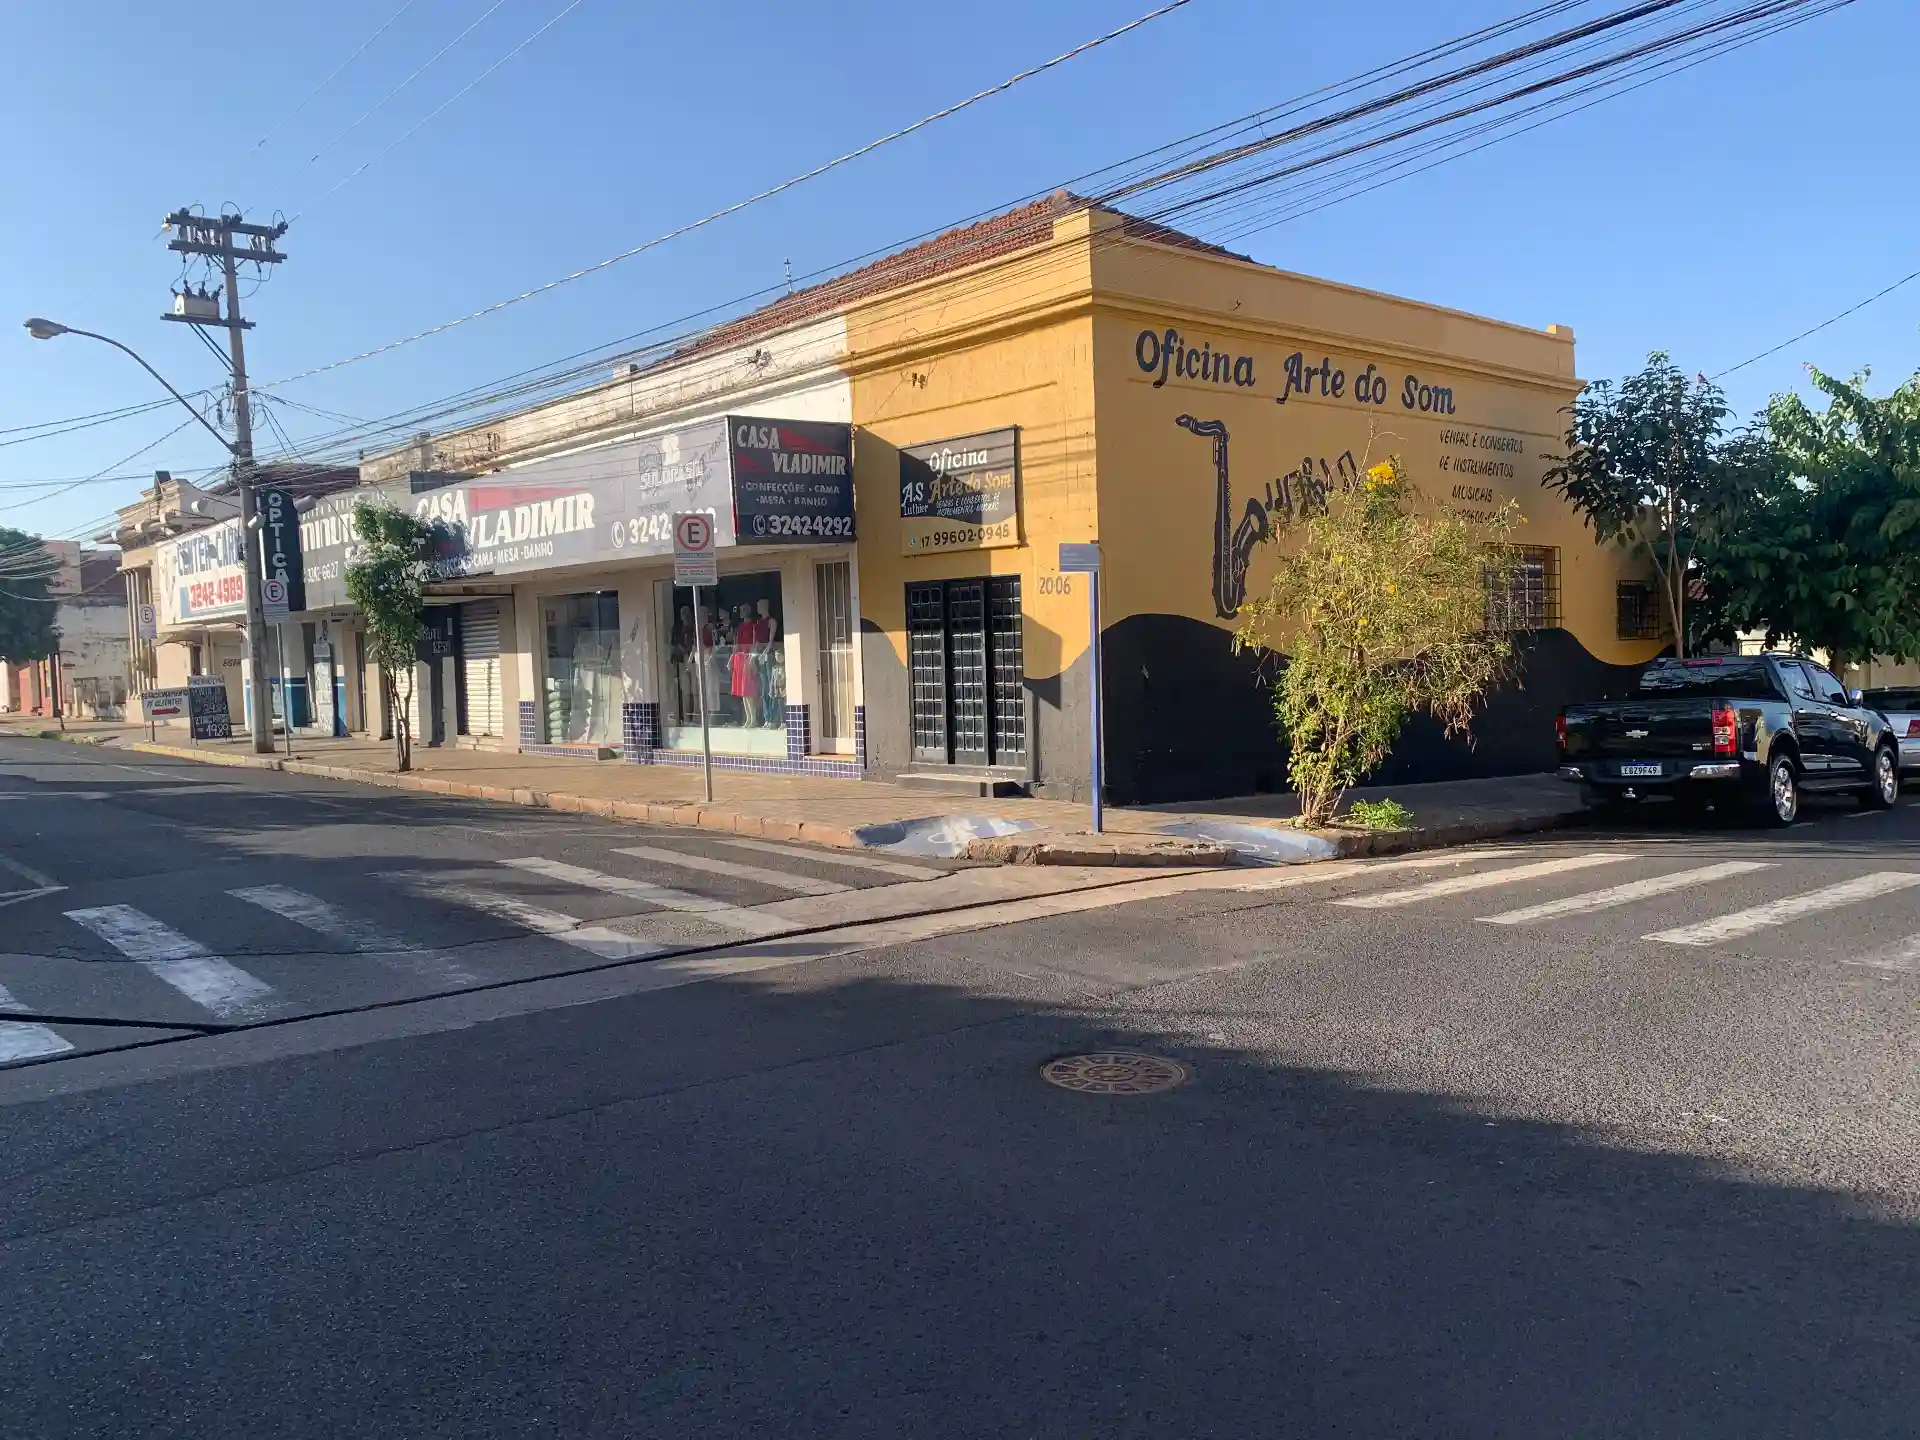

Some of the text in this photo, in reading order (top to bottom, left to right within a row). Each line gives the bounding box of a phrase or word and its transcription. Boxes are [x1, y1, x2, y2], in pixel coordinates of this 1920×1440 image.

[1135, 327, 1456, 415] Oficina Arte do Som
[736, 424, 781, 450] CASA
[1439, 428, 1469, 447] VENDAS
[1480, 435, 1524, 454] CONSERTOS
[771, 451, 848, 476] VLADIMIR
[929, 447, 989, 479] Oficina
[1439, 455, 1514, 478] DE INSTRUMENTOS
[745, 481, 840, 495] CONFECÇÕES CAMA
[928, 474, 964, 504] Arte
[984, 470, 1012, 489] Som
[1452, 484, 1493, 503] MUSICAIS
[416, 489, 468, 524] CASA
[759, 495, 828, 507] MESA BANHO
[903, 503, 929, 516] Luthier
[467, 492, 596, 549] VLADIMIR
[687, 522, 701, 544] E
[921, 535, 930, 548] 17
[474, 553, 494, 567] CAMA
[497, 548, 520, 565] MESA
[524, 541, 554, 560] BANHO
[270, 585, 279, 598] E
[144, 609, 150, 620] E
